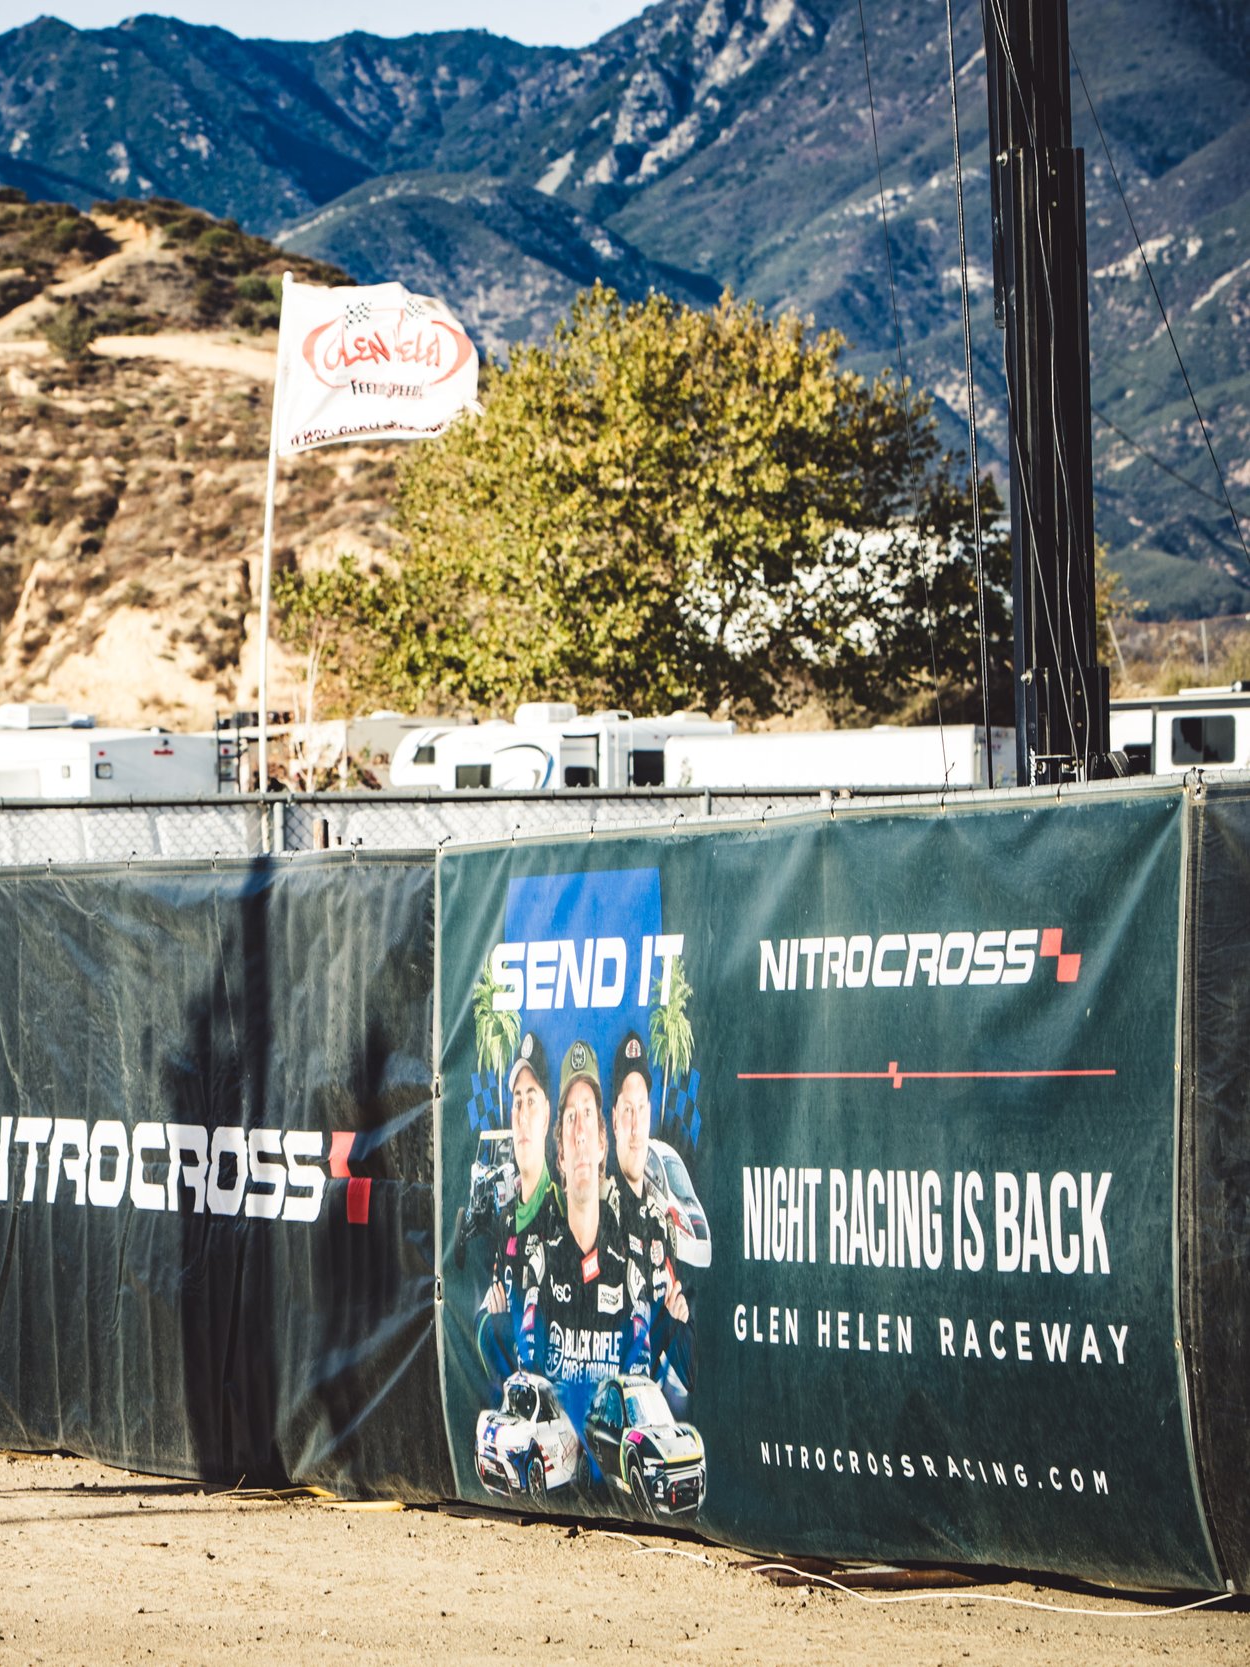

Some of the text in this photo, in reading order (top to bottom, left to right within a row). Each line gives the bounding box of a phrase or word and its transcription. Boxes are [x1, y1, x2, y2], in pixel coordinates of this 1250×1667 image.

[491, 934, 685, 1010] SEND IT
[759, 929, 1039, 991] NITROCROSS
[743, 1166, 1113, 1275] NIGHT RACING IS BACK
[592, 1330, 623, 1363] RIFLE
[734, 1304, 1129, 1365] GLEN HELEN RACEWAY
[760, 1441, 1110, 1496] NITROCROSSRACING.COM
